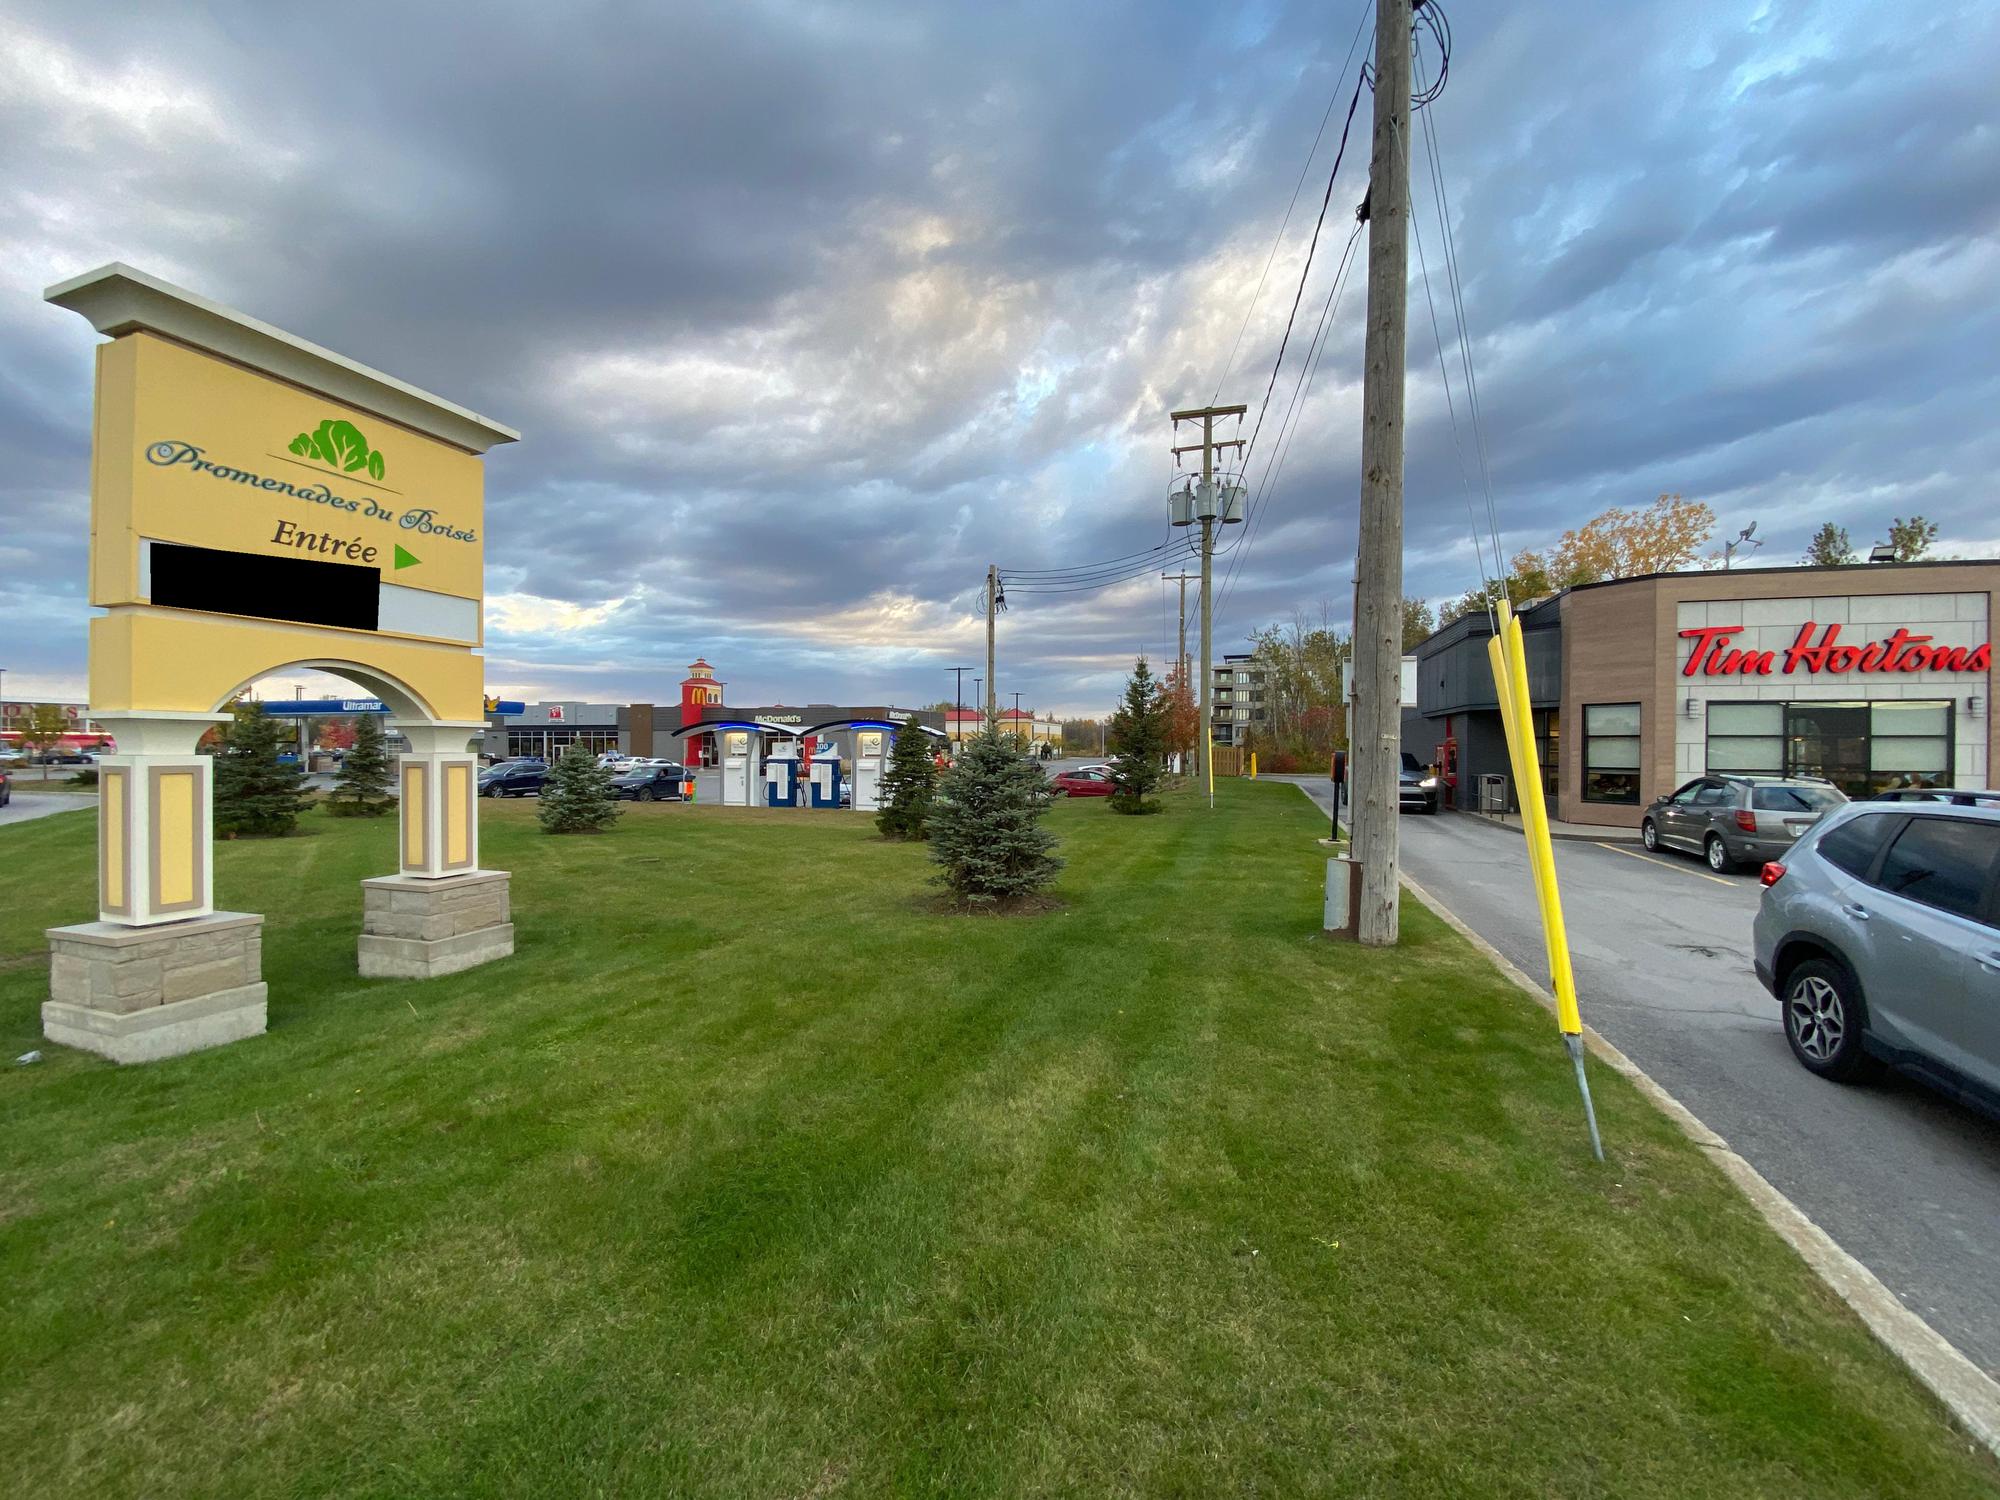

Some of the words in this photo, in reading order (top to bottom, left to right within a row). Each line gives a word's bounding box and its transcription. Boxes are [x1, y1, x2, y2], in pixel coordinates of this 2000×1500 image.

[146, 440, 360, 512] Promenades
[362, 497, 394, 522] du
[398, 508, 478, 543] Boisé
[270, 519, 378, 563] Entrée
[1678, 626, 1775, 677] Tim
[1782, 621, 1993, 675] Hortons
[342, 701, 383, 711] Ultramar
[754, 715, 802, 723] McDonald's
